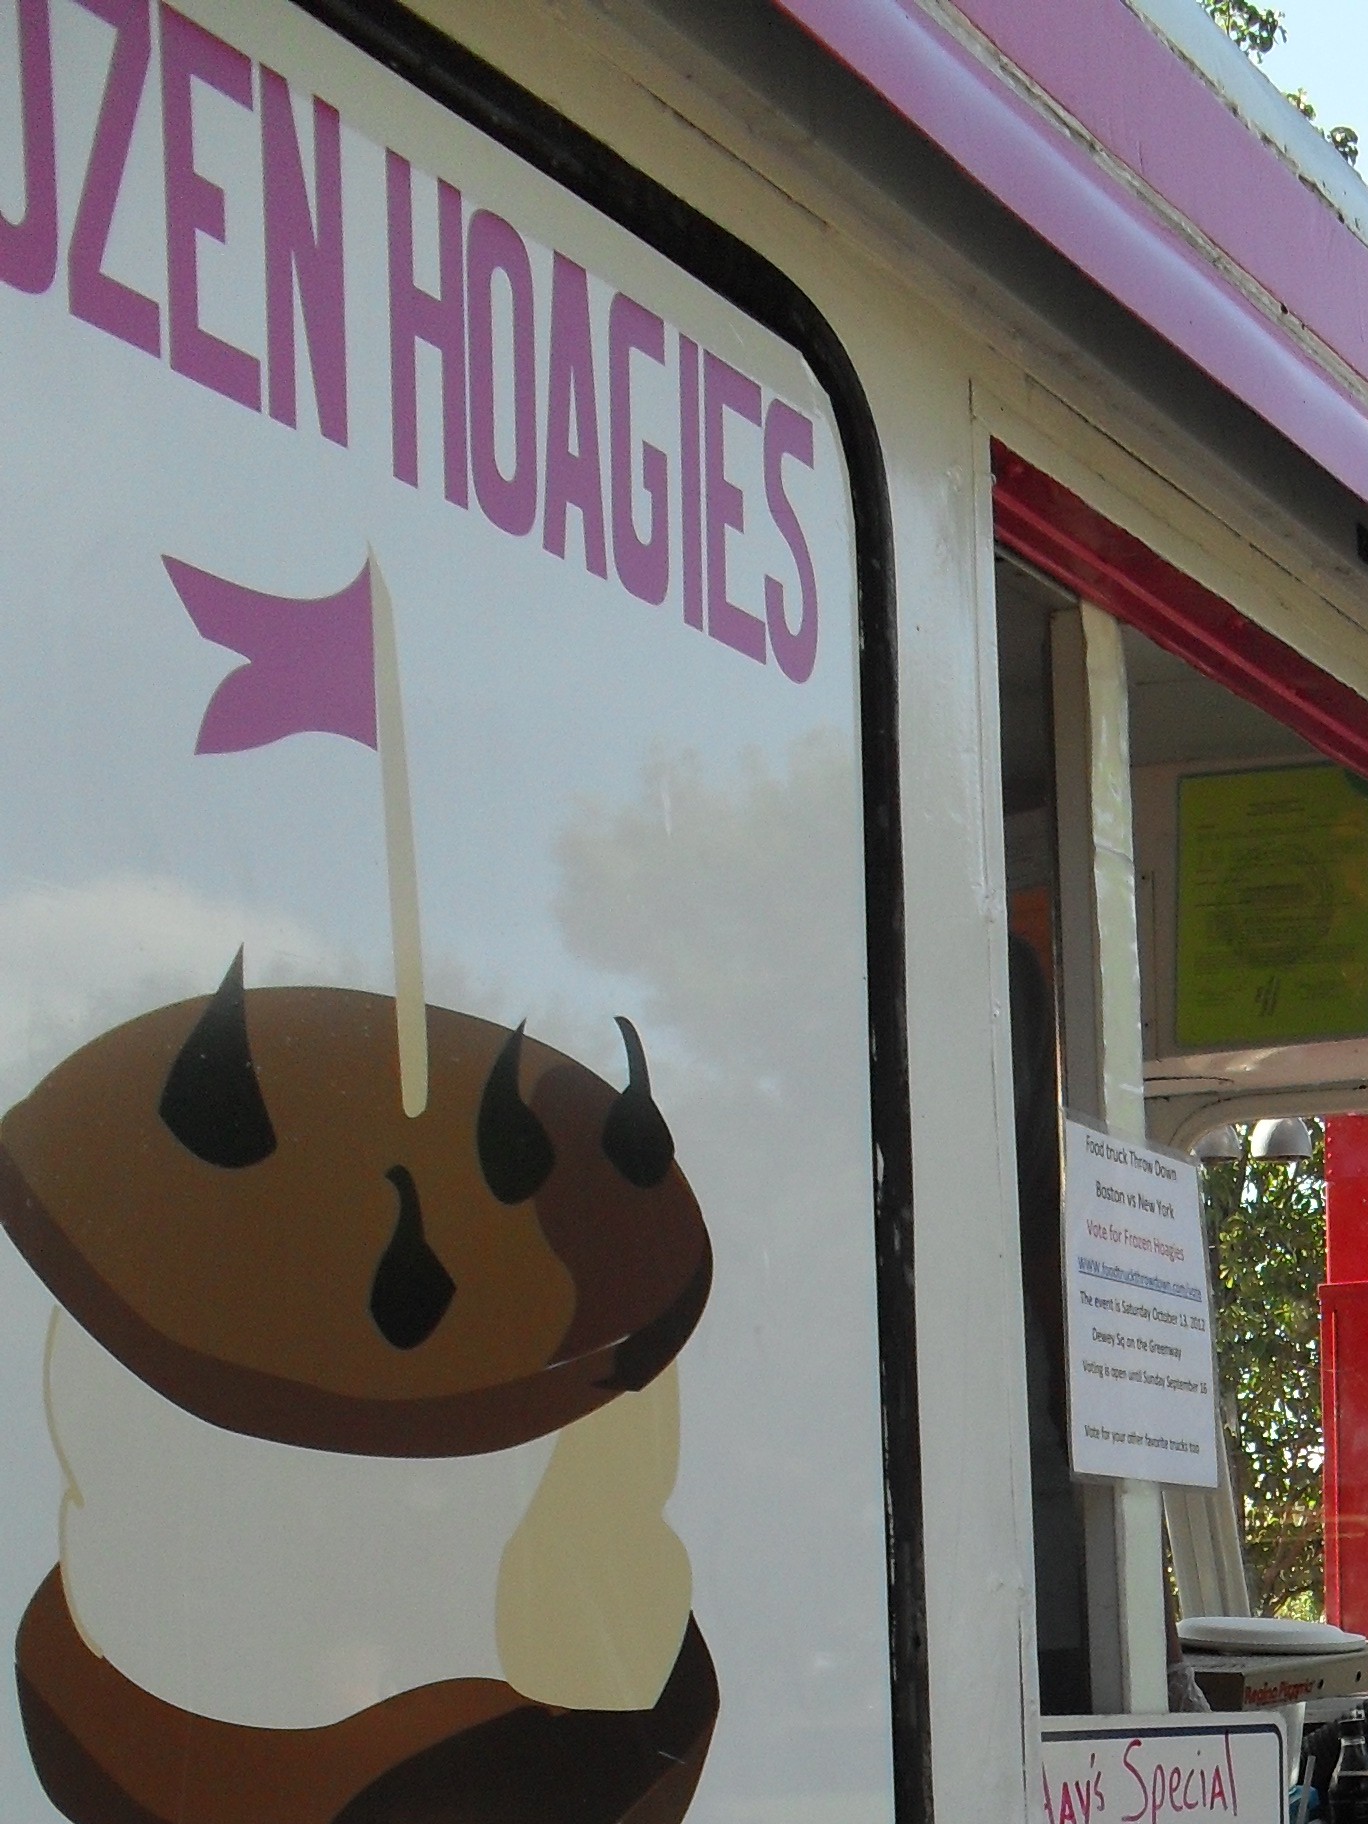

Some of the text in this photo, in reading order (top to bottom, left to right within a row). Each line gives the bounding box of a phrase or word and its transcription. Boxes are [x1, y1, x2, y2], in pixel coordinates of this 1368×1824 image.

[385, 147, 818, 684] HOAGIES
[1085, 1135, 1105, 1157] Food
[1106, 1144, 1127, 1165] truck
[1095, 1180, 1175, 1219] Boston vs New York
[1087, 1219, 1184, 1263] Vote for Frozen Hoagies
[1080, 1290, 1093, 1305] The
